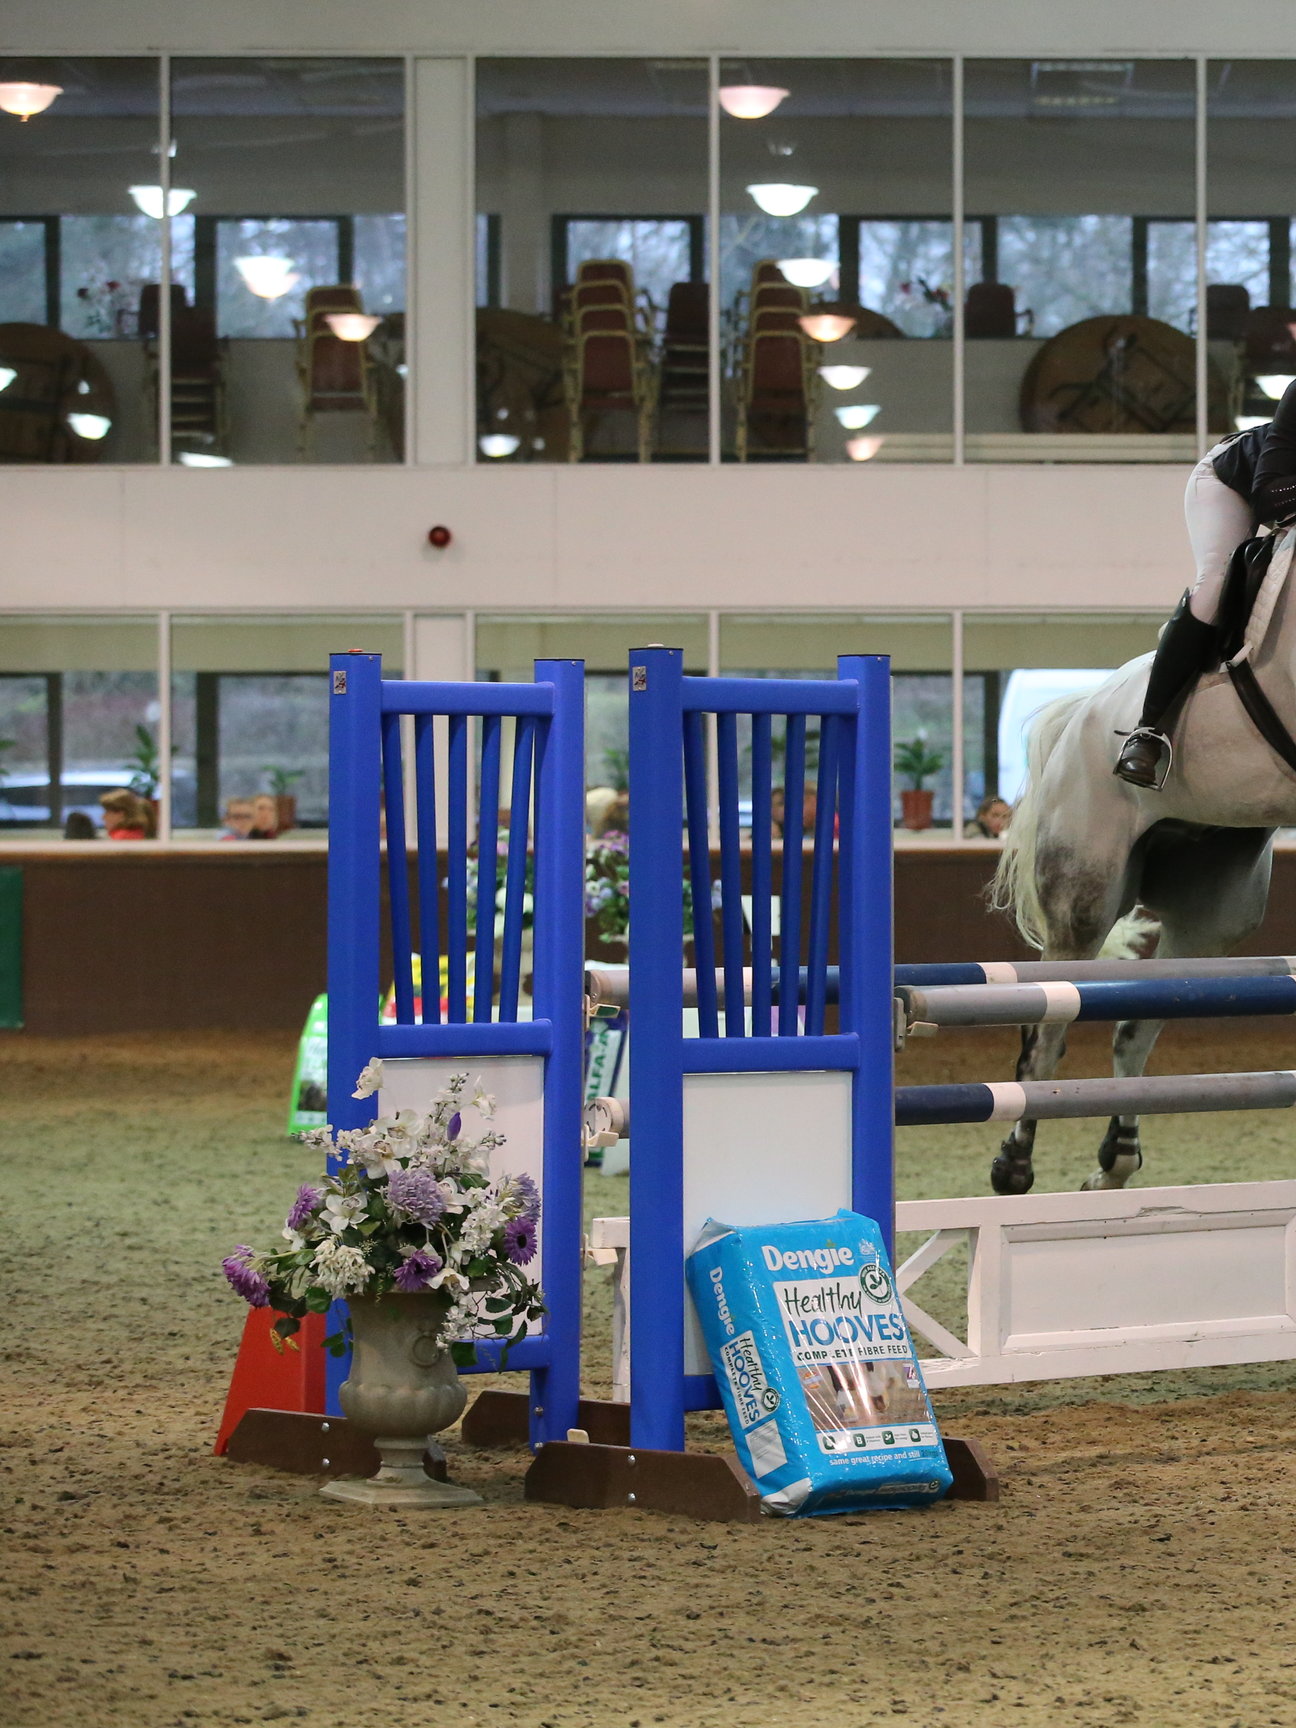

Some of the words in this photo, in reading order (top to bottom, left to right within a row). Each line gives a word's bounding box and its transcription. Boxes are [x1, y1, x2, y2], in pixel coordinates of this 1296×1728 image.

[761, 1245, 854, 1274] Dengie
[709, 1266, 735, 1336] Dengie
[784, 1282, 862, 1317] Healthy
[788, 1313, 905, 1347] HOOVES
[740, 1337, 763, 1392] Healthy
[858, 1346, 885, 1356] FIBRE
[887, 1345, 908, 1354] FEED
[729, 1341, 760, 1422] HOOVES
[829, 1457, 849, 1466] same
[851, 1456, 870, 1465] great
[871, 1454, 893, 1464] recipe
[894, 1451, 907, 1460] and
[908, 1450, 920, 1458] still
